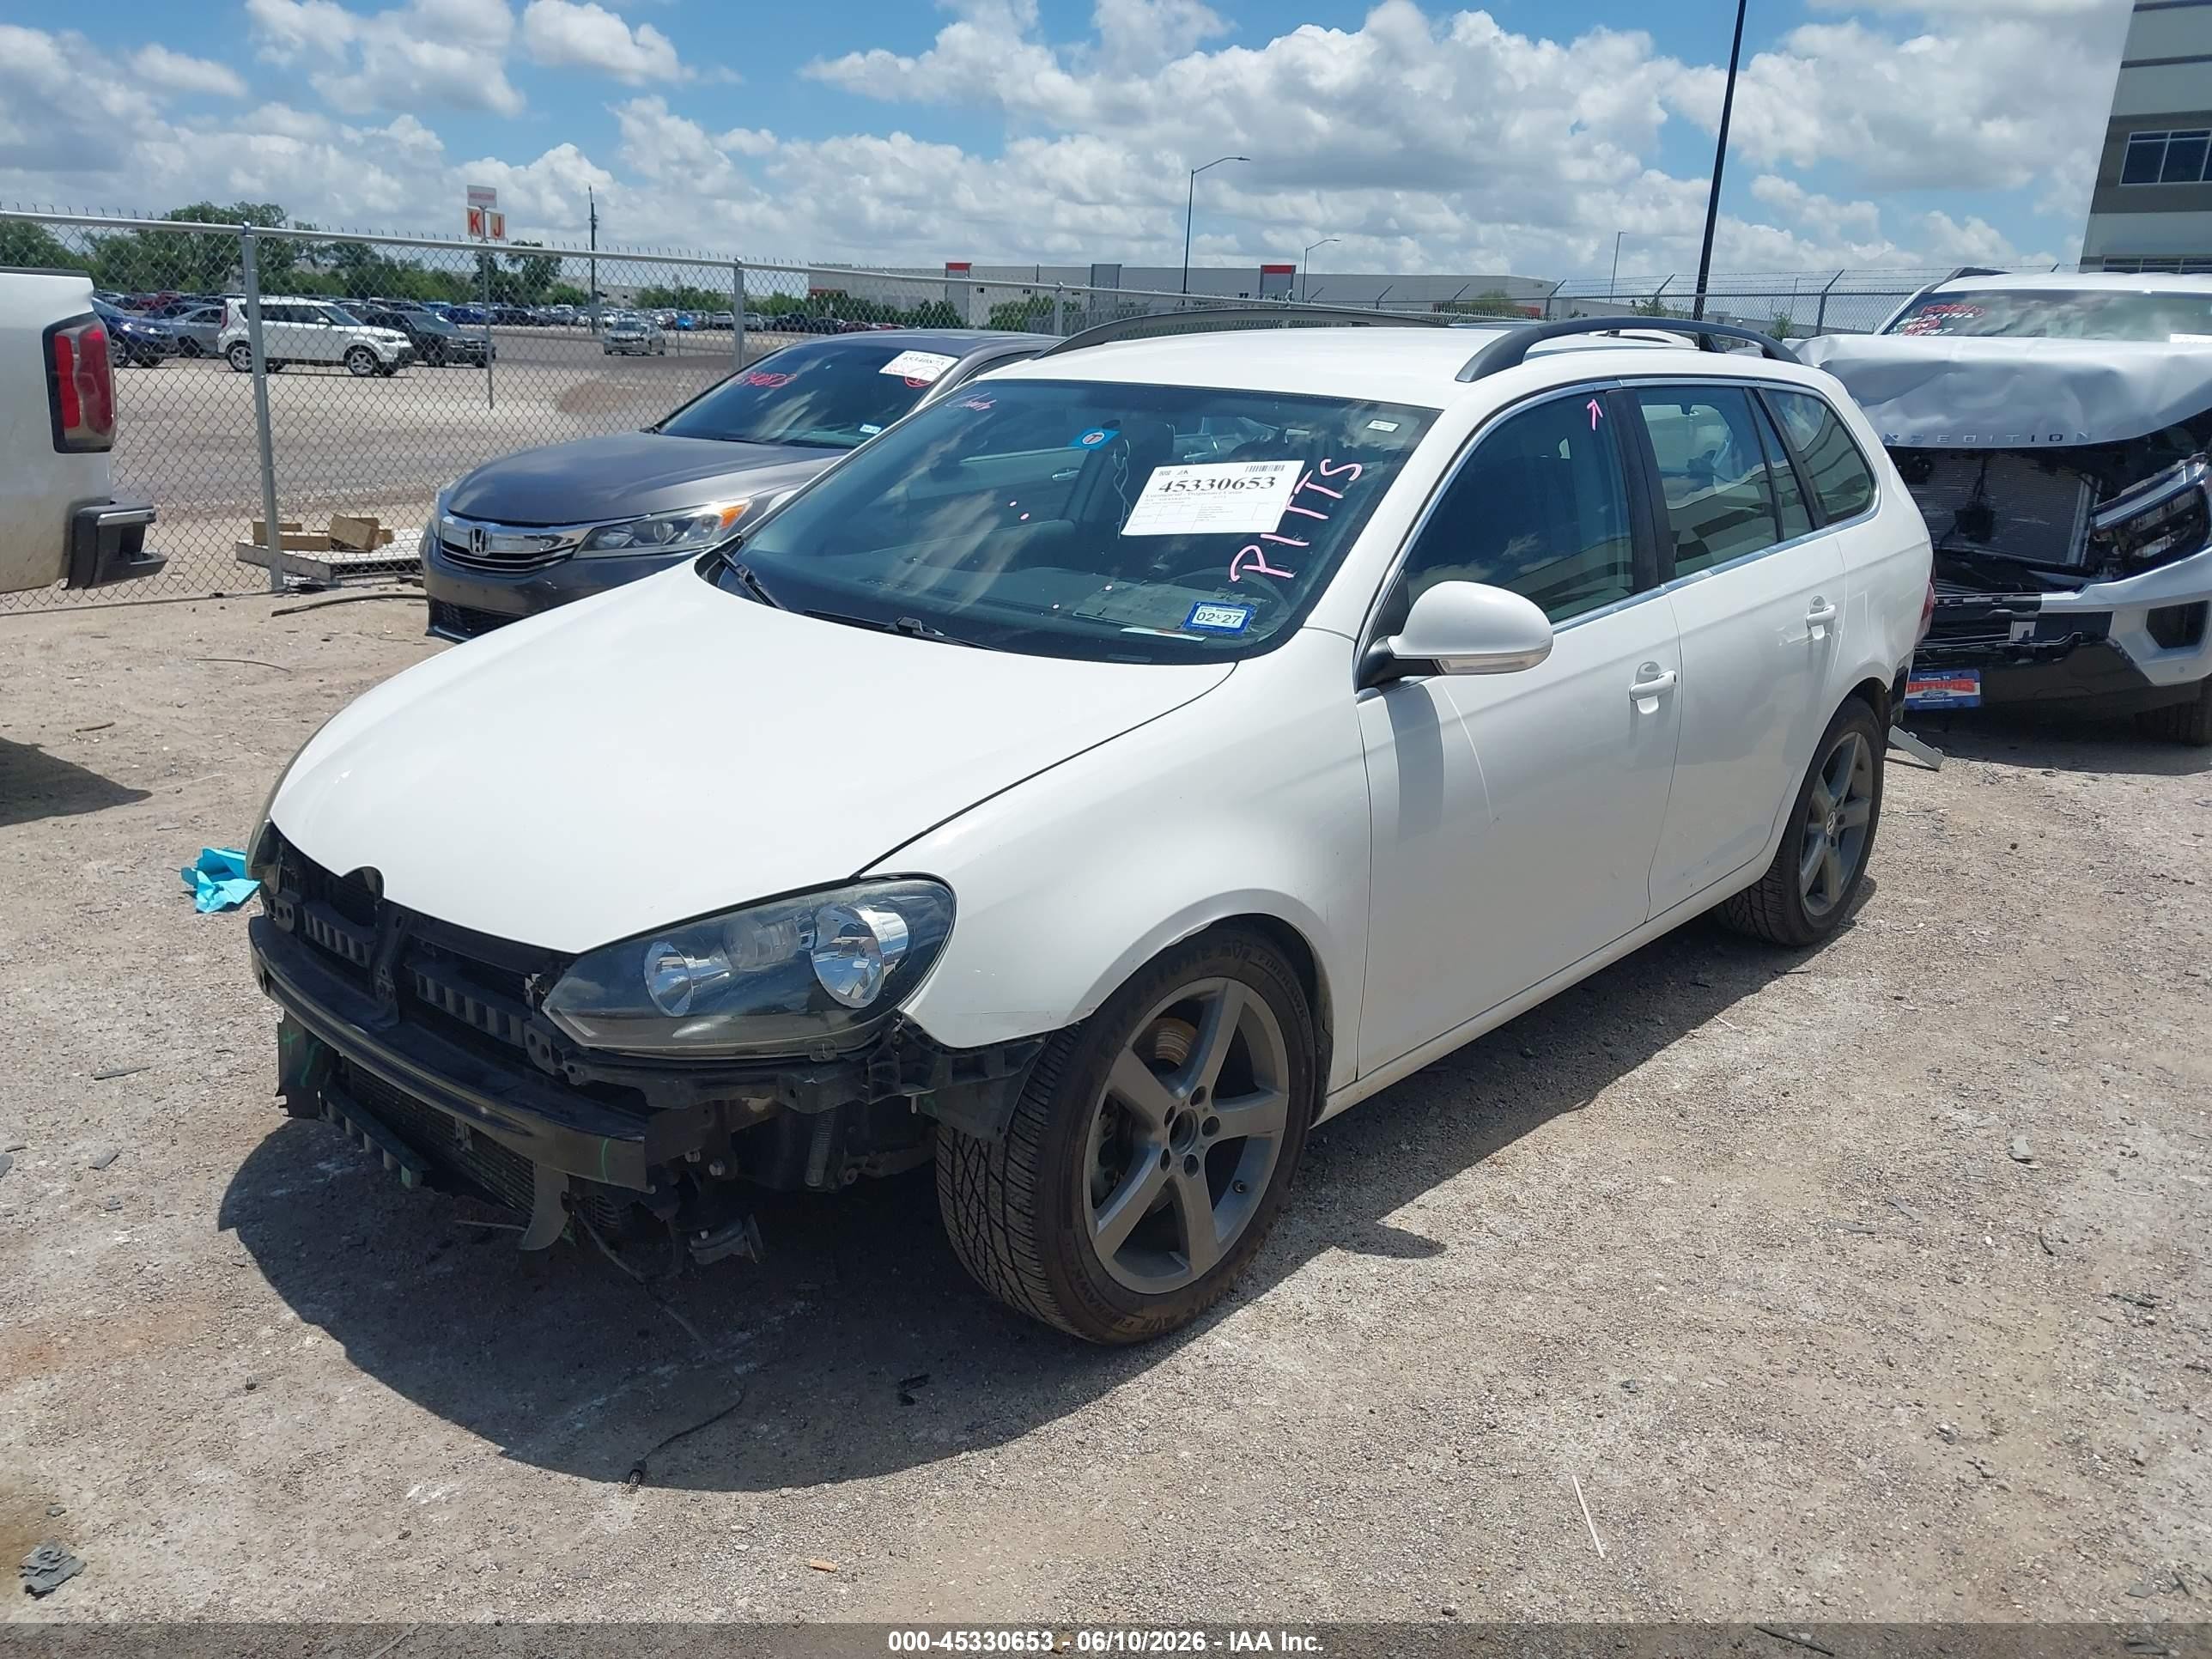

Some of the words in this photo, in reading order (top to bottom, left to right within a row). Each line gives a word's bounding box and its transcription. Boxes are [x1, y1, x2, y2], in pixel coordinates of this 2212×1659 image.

[470, 211, 481, 234] K
[493, 216, 501, 237] J
[1883, 433, 2090, 443] XPEDITION
[1158, 477, 1277, 493] 45330653
[1230, 459, 1362, 582] PITTS
[1196, 611, 1216, 623] 02
[1220, 614, 1243, 624] 27
